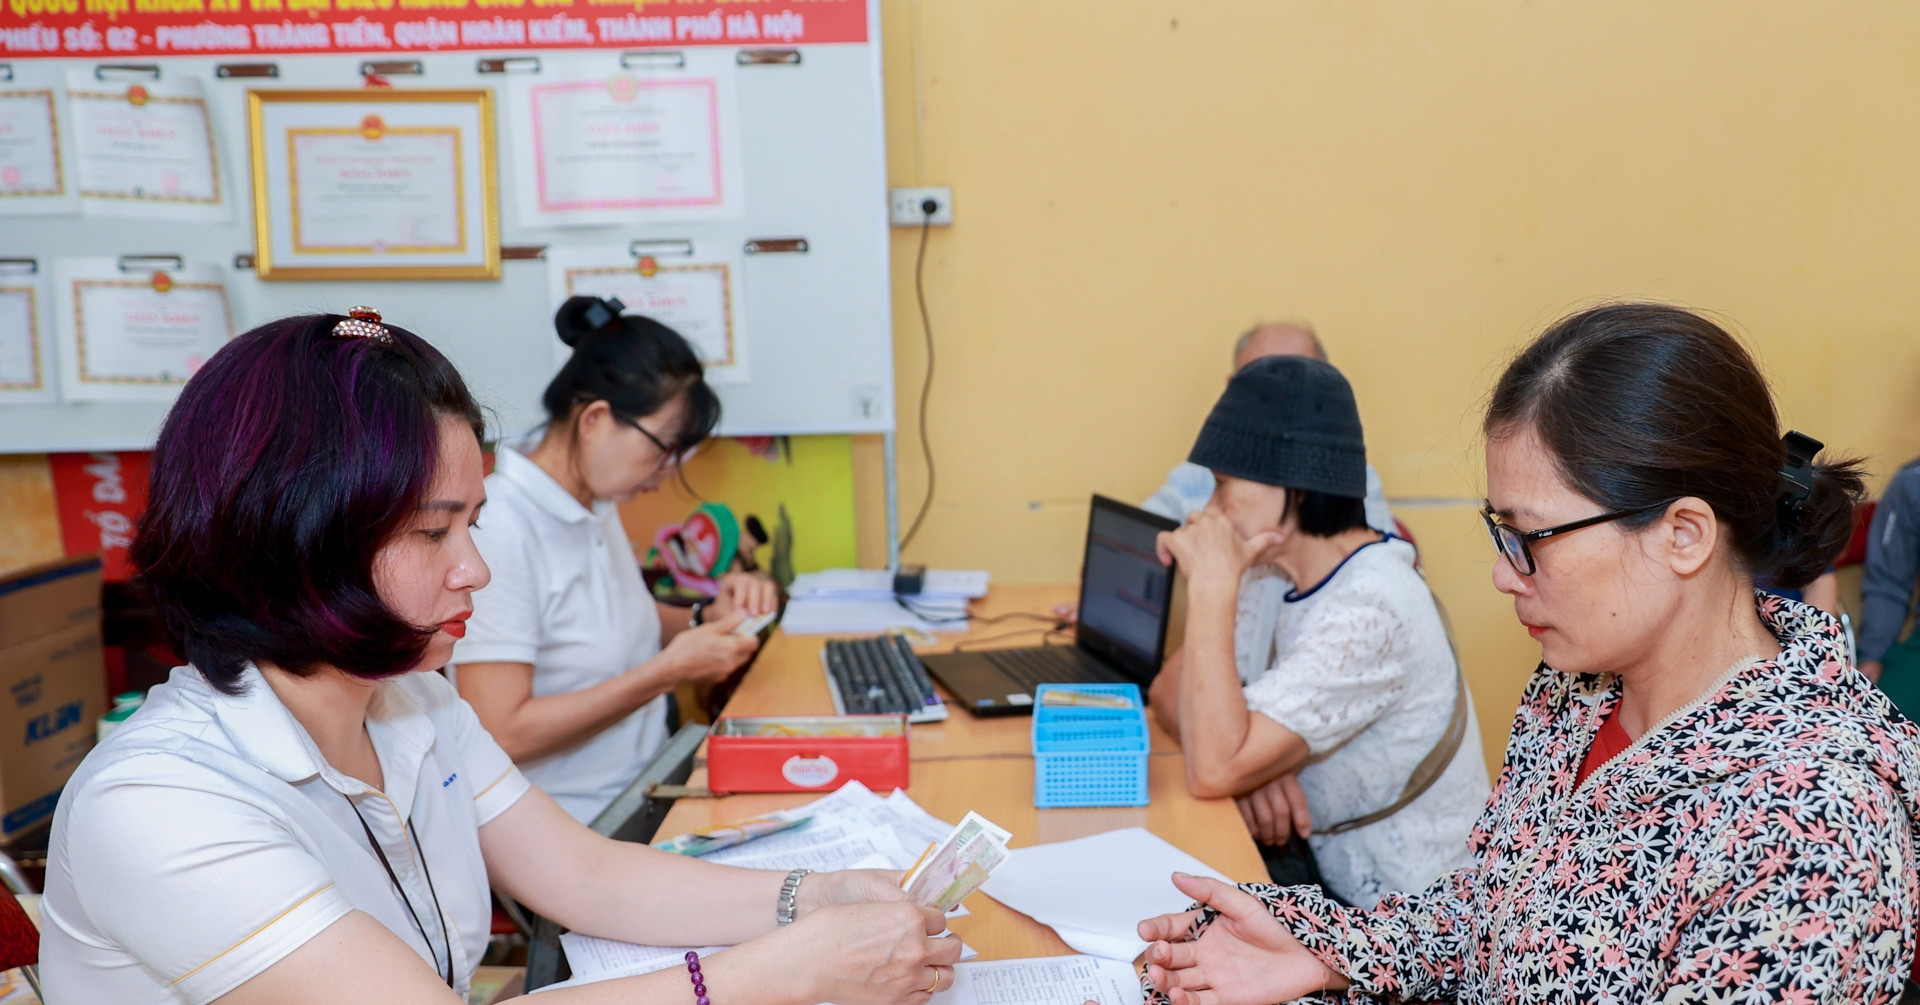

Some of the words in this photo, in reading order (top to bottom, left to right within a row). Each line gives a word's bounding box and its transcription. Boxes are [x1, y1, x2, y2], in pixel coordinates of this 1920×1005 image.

[63, 19, 103, 51] SỐ:
[106, 26, 137, 51] 02
[156, 20, 250, 50] PHƯỜNG
[252, 19, 330, 48] TRÀNG
[394, 16, 458, 50] QUẬN
[461, 16, 525, 45] HOÀN
[597, 13, 672, 42] THÀNH
[676, 8, 723, 40] PHỐ
[726, 10, 759, 39] HÀ
[762, 9, 804, 42] NỘI
